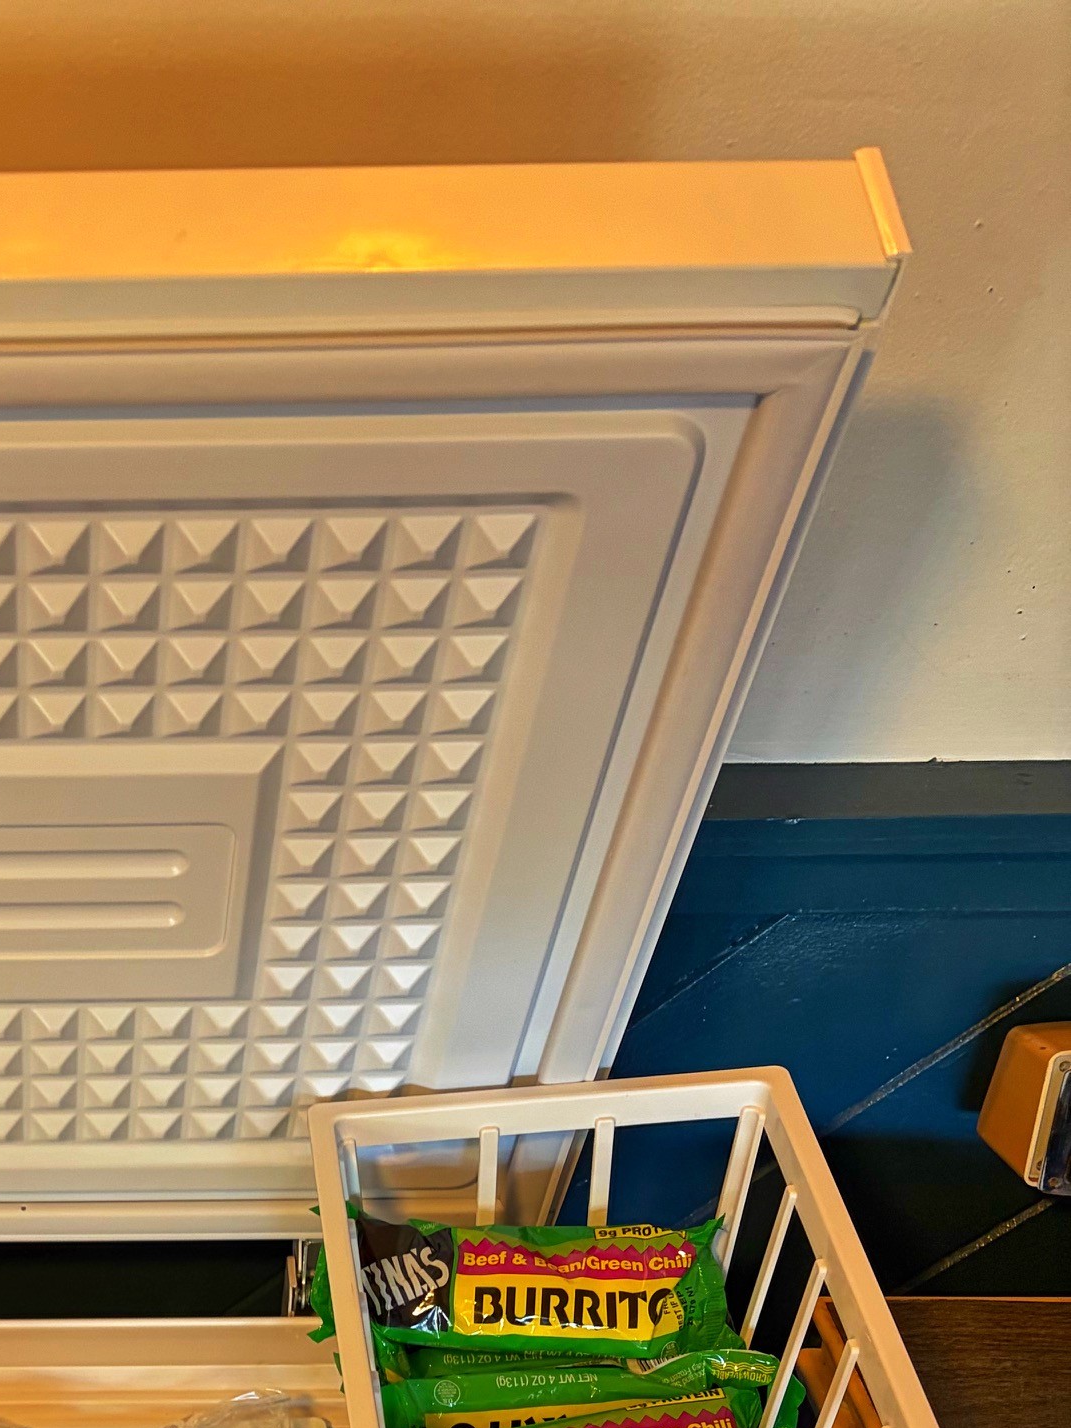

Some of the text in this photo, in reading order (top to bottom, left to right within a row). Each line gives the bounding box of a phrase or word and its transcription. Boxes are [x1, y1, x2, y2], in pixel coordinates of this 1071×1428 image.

[598, 1229, 617, 1239] 9g
[463, 1251, 507, 1267] Beef
[512, 1252, 528, 1267] &
[648, 1254, 692, 1270] Chili
[496, 1373, 598, 1389] NET WT 4 OZ (113g)
